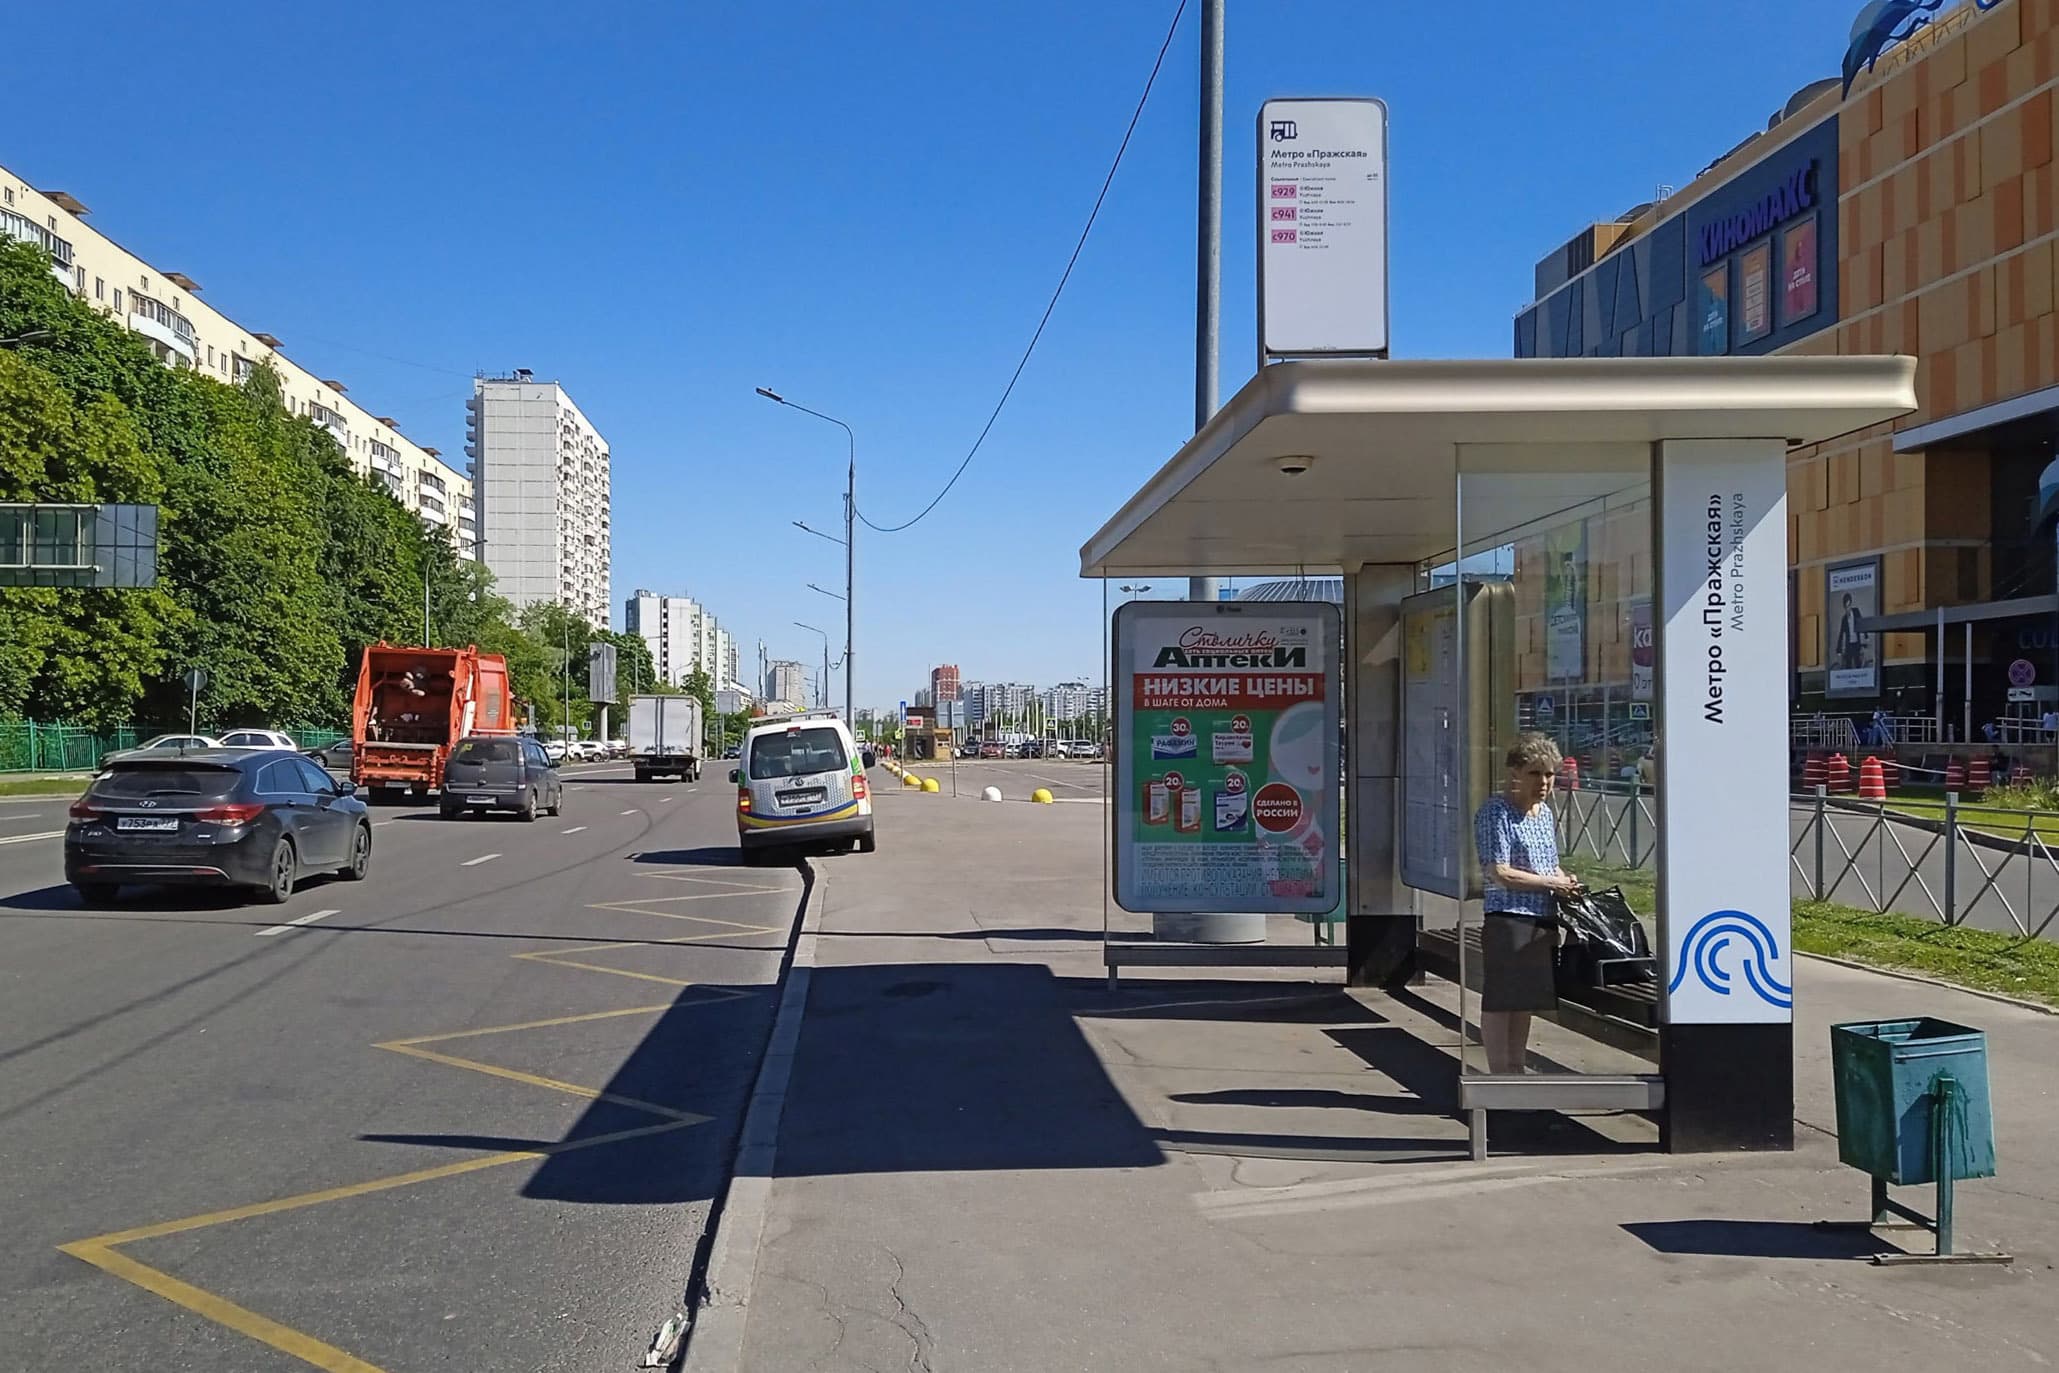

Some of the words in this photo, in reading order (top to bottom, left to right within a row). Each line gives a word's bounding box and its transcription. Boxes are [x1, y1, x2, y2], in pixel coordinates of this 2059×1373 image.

[1271, 150, 1304, 159] Метро
[1307, 150, 1367, 160] «Пражская»
[1699, 165, 1814, 266] КИНОМАКС
[1730, 492, 1746, 578] Prazhskaya
[1703, 494, 1726, 638] «Пражская»
[1730, 583, 1744, 631] Metro
[1144, 678, 1240, 695] НИЗКИЕ
[1247, 678, 1313, 697] ЦЕНЫ
[1144, 698, 1150, 707] В
[1152, 698, 1179, 707] ШАГЕ
[1181, 698, 1194, 707] ОТ
[1196, 698, 1228, 707] ДОМА
[1704, 645, 1726, 724] Метро
[1257, 809, 1298, 817] РОССИИ
